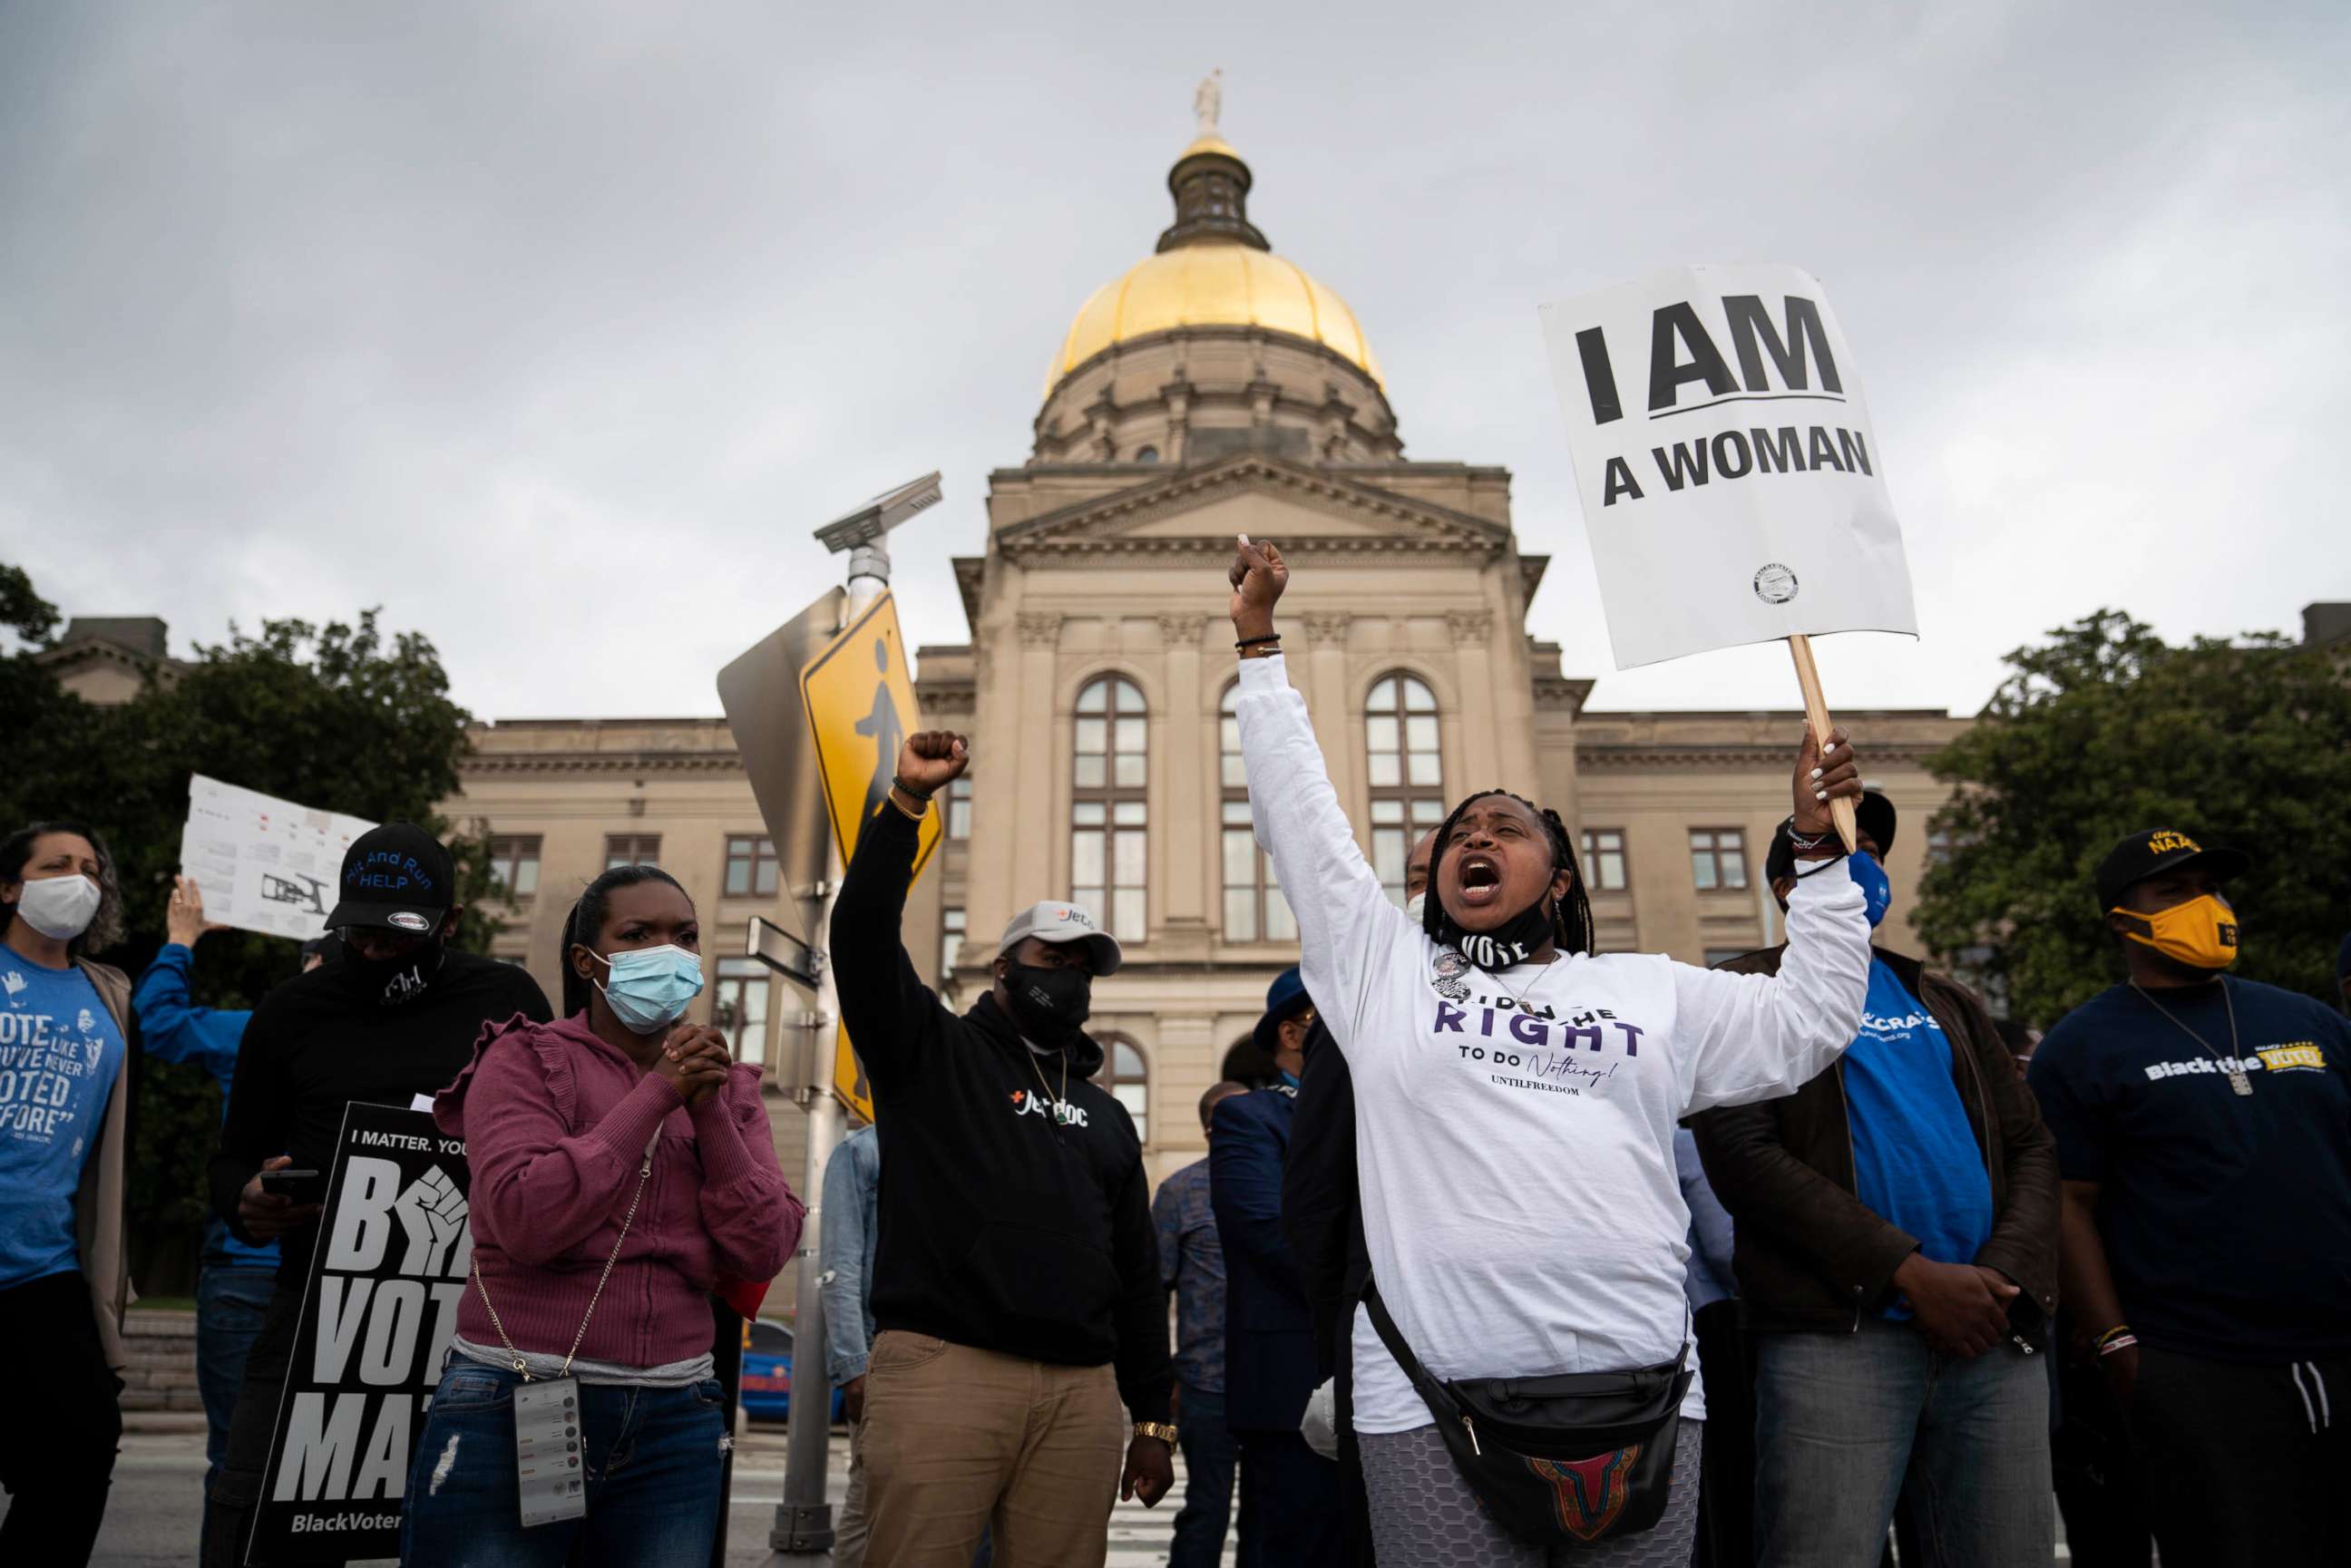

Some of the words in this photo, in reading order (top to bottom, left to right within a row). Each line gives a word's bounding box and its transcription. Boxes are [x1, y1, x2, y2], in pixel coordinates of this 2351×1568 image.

[1575, 326, 1624, 424] I
[1648, 295, 1843, 411] AM
[1604, 456, 1644, 507] A
[1651, 425, 1873, 492] WOMAN
[359, 873, 408, 890] HELP
[366, 851, 402, 865] And
[404, 857, 433, 891] Run
[1461, 935, 1529, 968] VOTE
[0, 1012, 54, 1046] OTE
[1434, 1000, 1644, 1057] RIGHT
[0, 1047, 45, 1068] U'VE
[51, 1037, 79, 1058] LIKE
[45, 1054, 83, 1076] NEVER
[1458, 1046, 1485, 1060] TO
[1494, 1051, 1520, 1066] DO
[1527, 1052, 1618, 1087] Nothing!
[2145, 1057, 2217, 1080] Black
[0, 1070, 71, 1107] OTED
[1491, 1074, 1580, 1096] UNTILFREEDOM
[351, 1130, 358, 1144] I
[362, 1131, 432, 1152] MATTER.
[272, 1392, 434, 1502] MA
